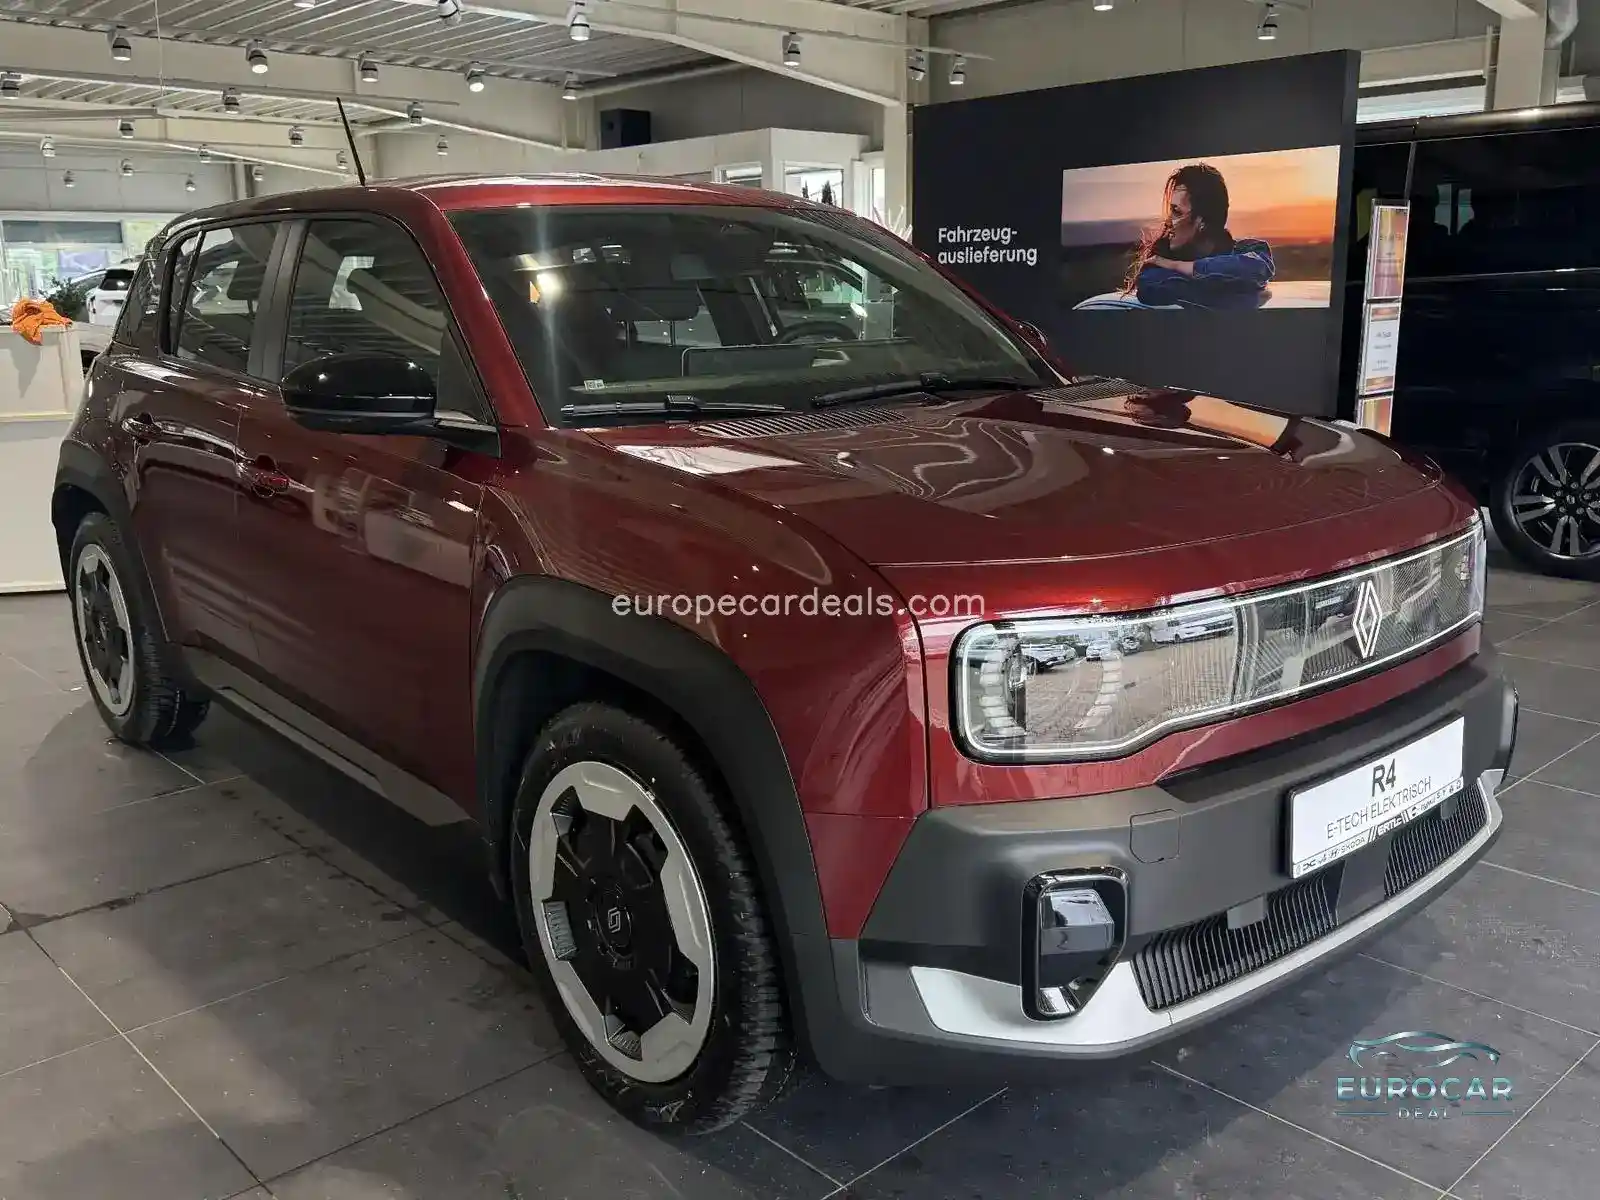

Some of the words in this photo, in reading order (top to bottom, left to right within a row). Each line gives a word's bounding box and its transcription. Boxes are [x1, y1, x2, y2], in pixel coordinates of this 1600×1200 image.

[938, 225, 1018, 245] Fahrzeug-
[937, 245, 1038, 267] auslieferung
[1371, 758, 1397, 797] R4
[1326, 808, 1369, 839] E-TECH
[1371, 775, 1432, 819] ELEKTRISCH
